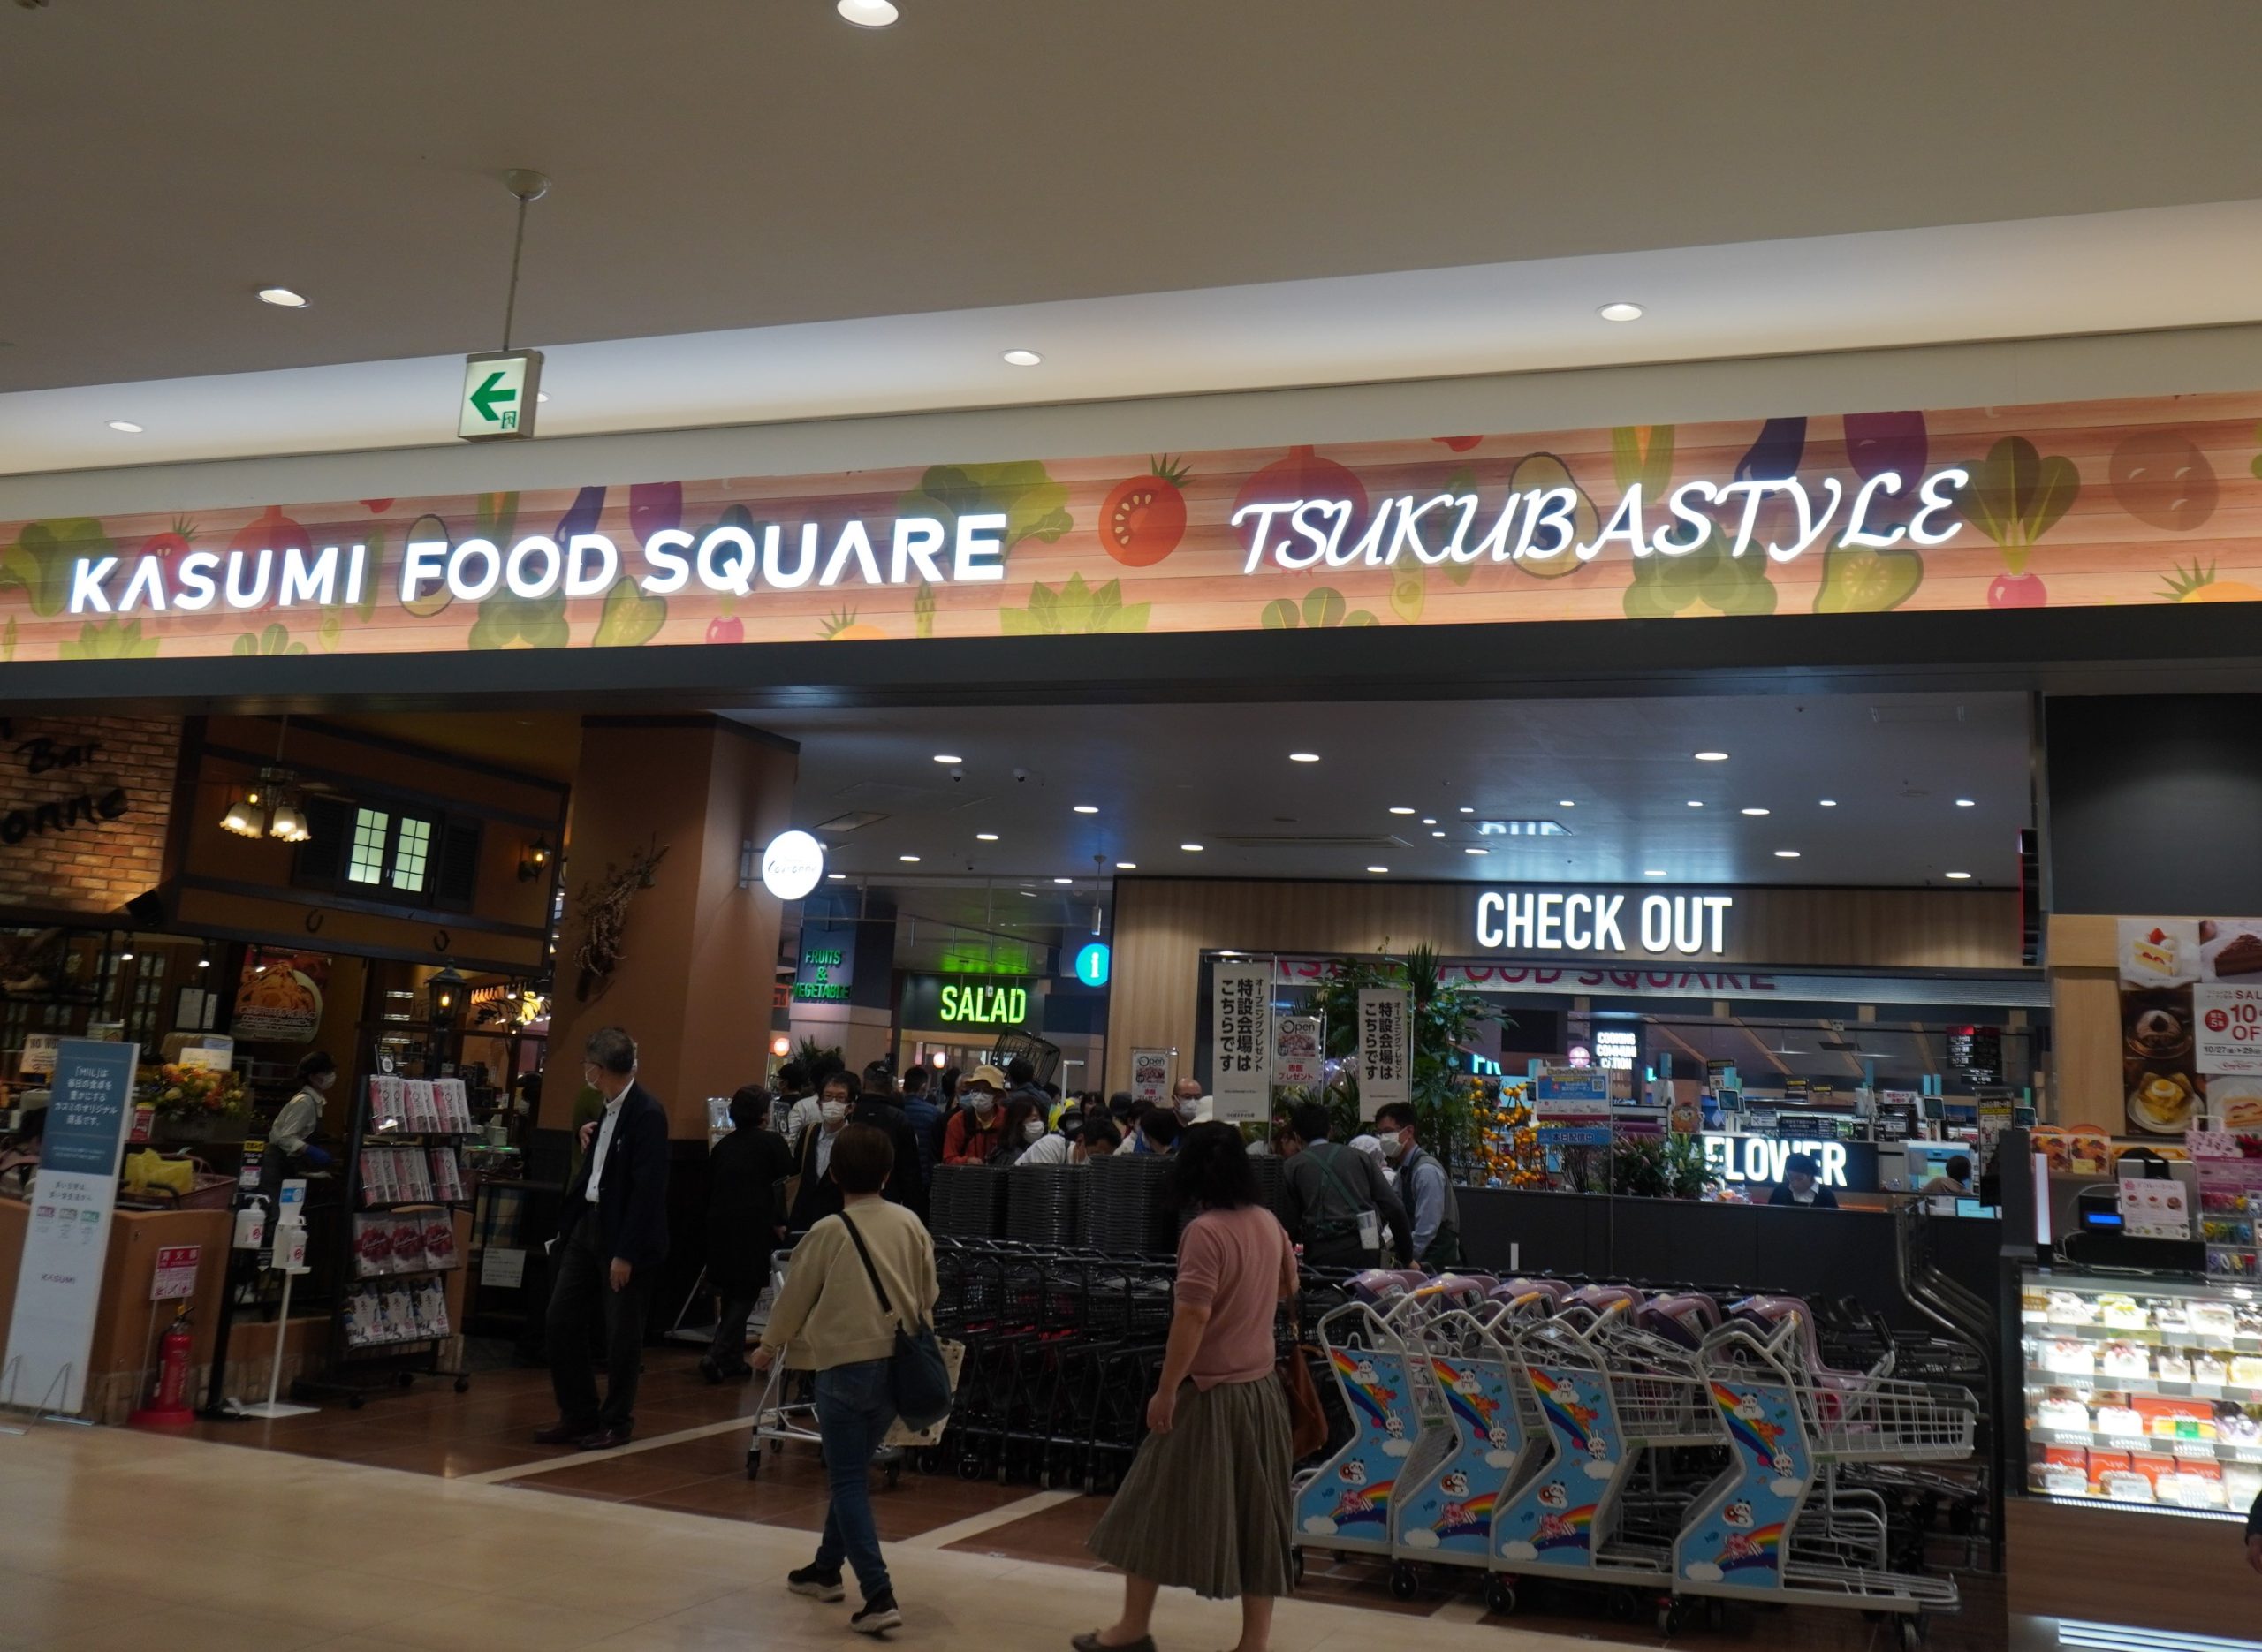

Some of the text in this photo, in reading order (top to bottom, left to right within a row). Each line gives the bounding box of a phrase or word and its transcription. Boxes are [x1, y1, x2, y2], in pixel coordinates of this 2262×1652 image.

[70, 513, 1006, 614] KASUMI FOOD SQUARE
[1477, 892, 1733, 953] CHECK OUT
[805, 949, 842, 965] FRUITS
[816, 966, 828, 981] &
[940, 985, 1026, 1024] SALAD
[1220, 980, 1235, 1072] こちらです
[1237, 978, 1253, 1072] 特設会場は
[1281, 1019, 1315, 1034] Open
[1138, 1056, 1165, 1066] Open
[1365, 1003, 1378, 1080] こちらです
[1378, 1002, 1393, 1080] 特設会場は
[1552, 1133, 1595, 1142] 本日配信中
